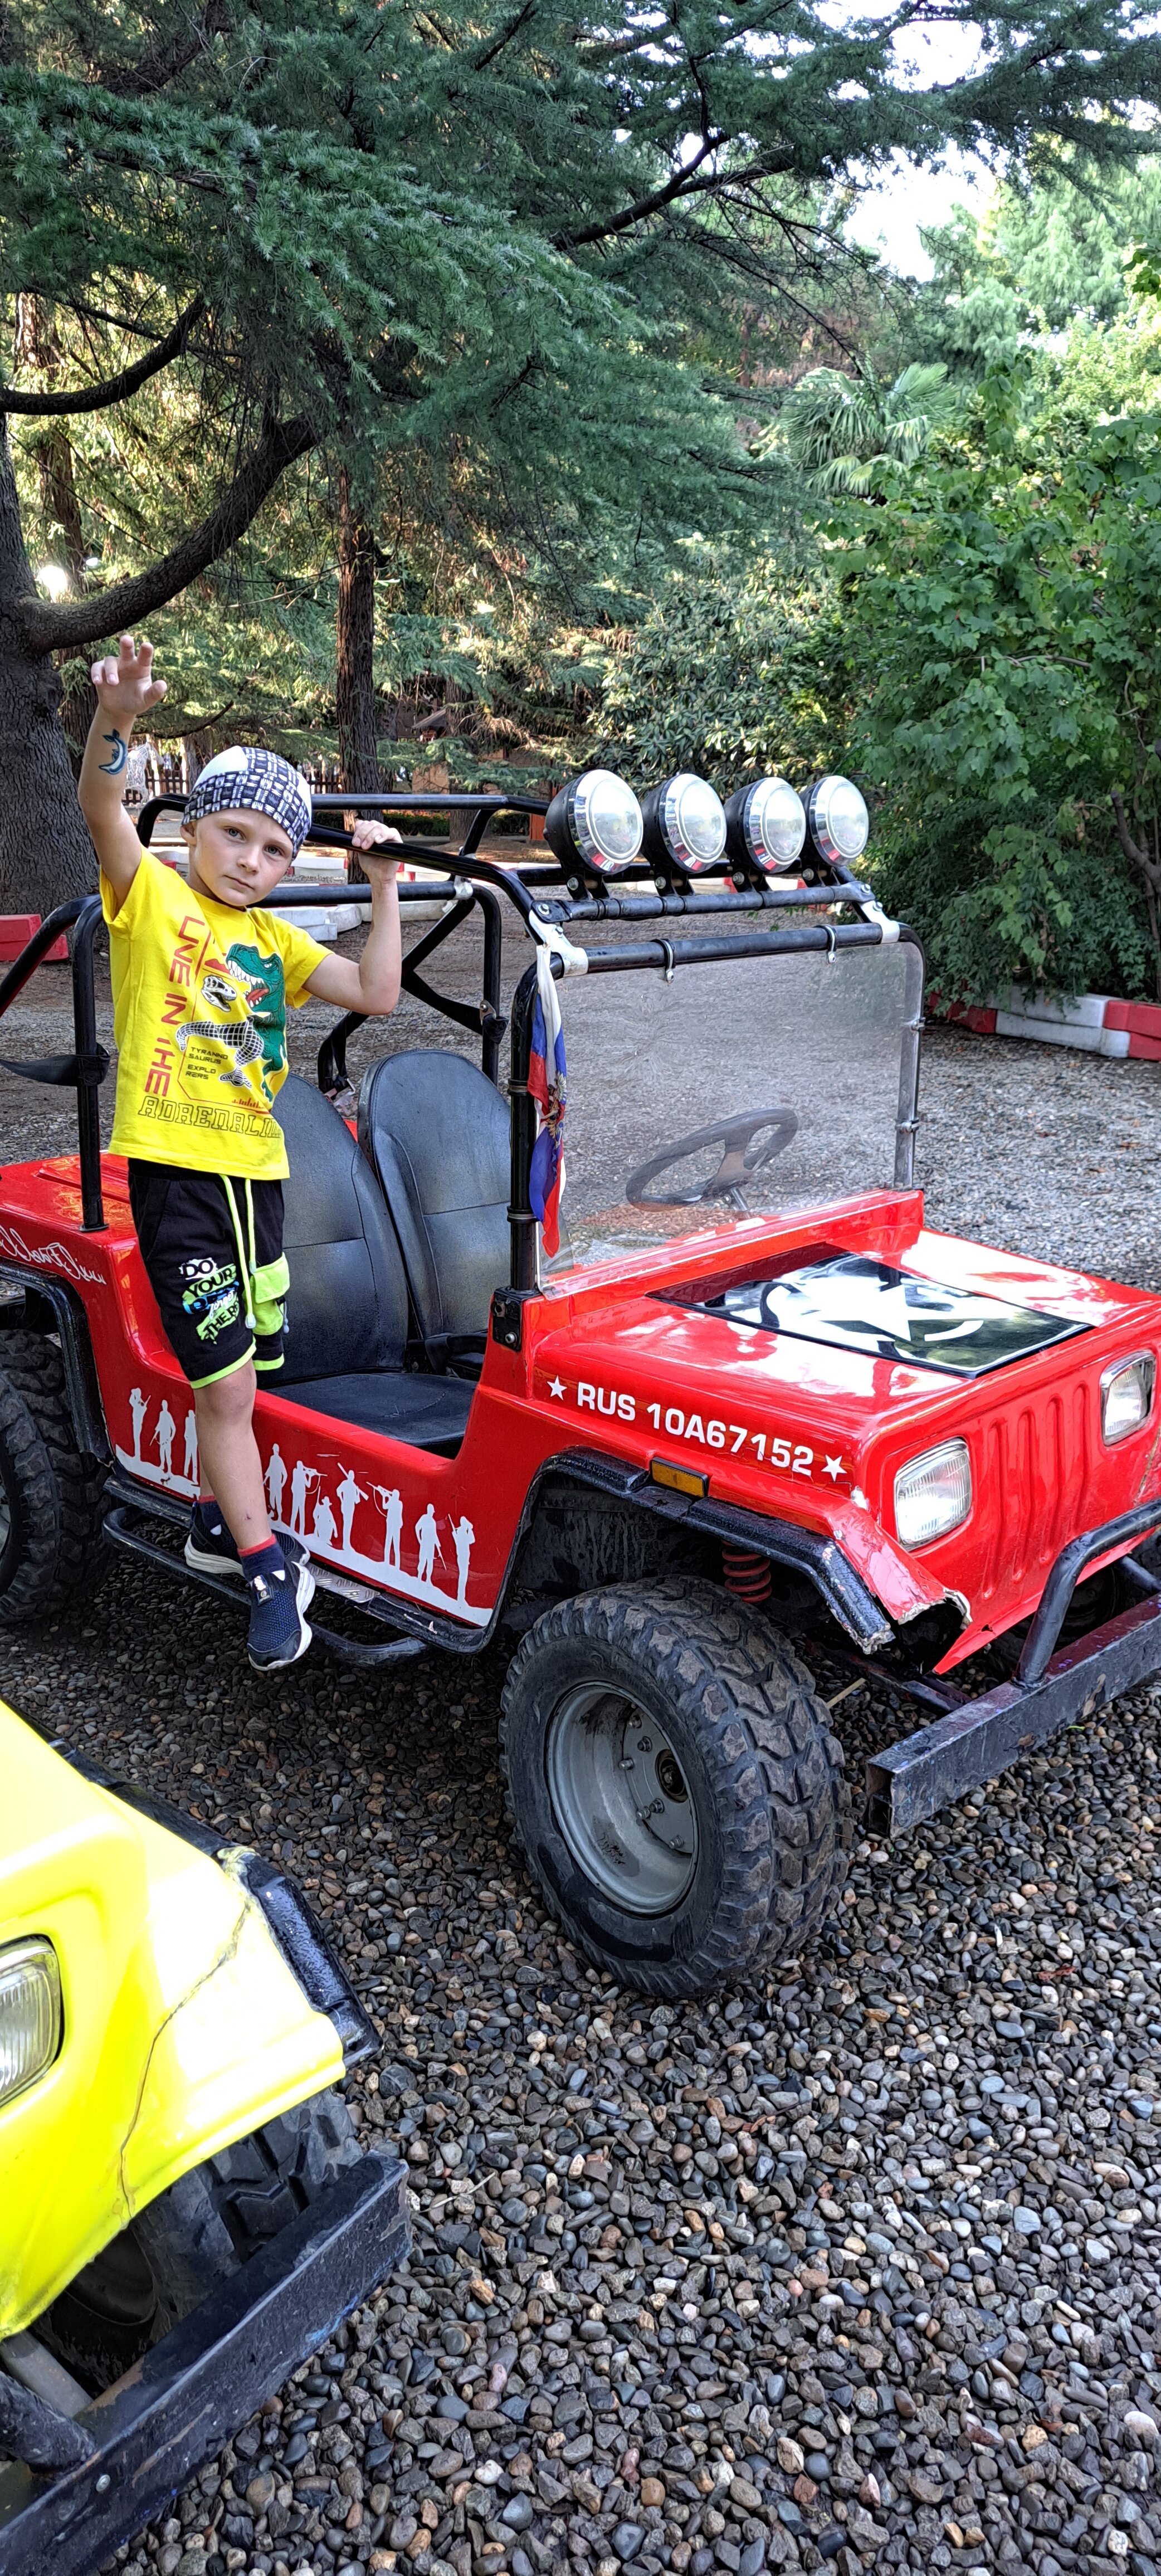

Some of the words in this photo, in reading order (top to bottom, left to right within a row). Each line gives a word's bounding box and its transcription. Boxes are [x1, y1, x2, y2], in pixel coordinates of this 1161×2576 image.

[161, 993, 188, 1025] IN
[188, 1053, 222, 1064] SAURUS
[191, 1047, 228, 1060] TYRANNO
[186, 1071, 209, 1080] RERS
[187, 1064, 216, 1074] EXPLO
[183, 1260, 214, 1279] DO
[187, 1267, 232, 1297] YOUR
[577, 1382, 636, 1421] RUS
[647, 1403, 814, 1476] 10A67152
